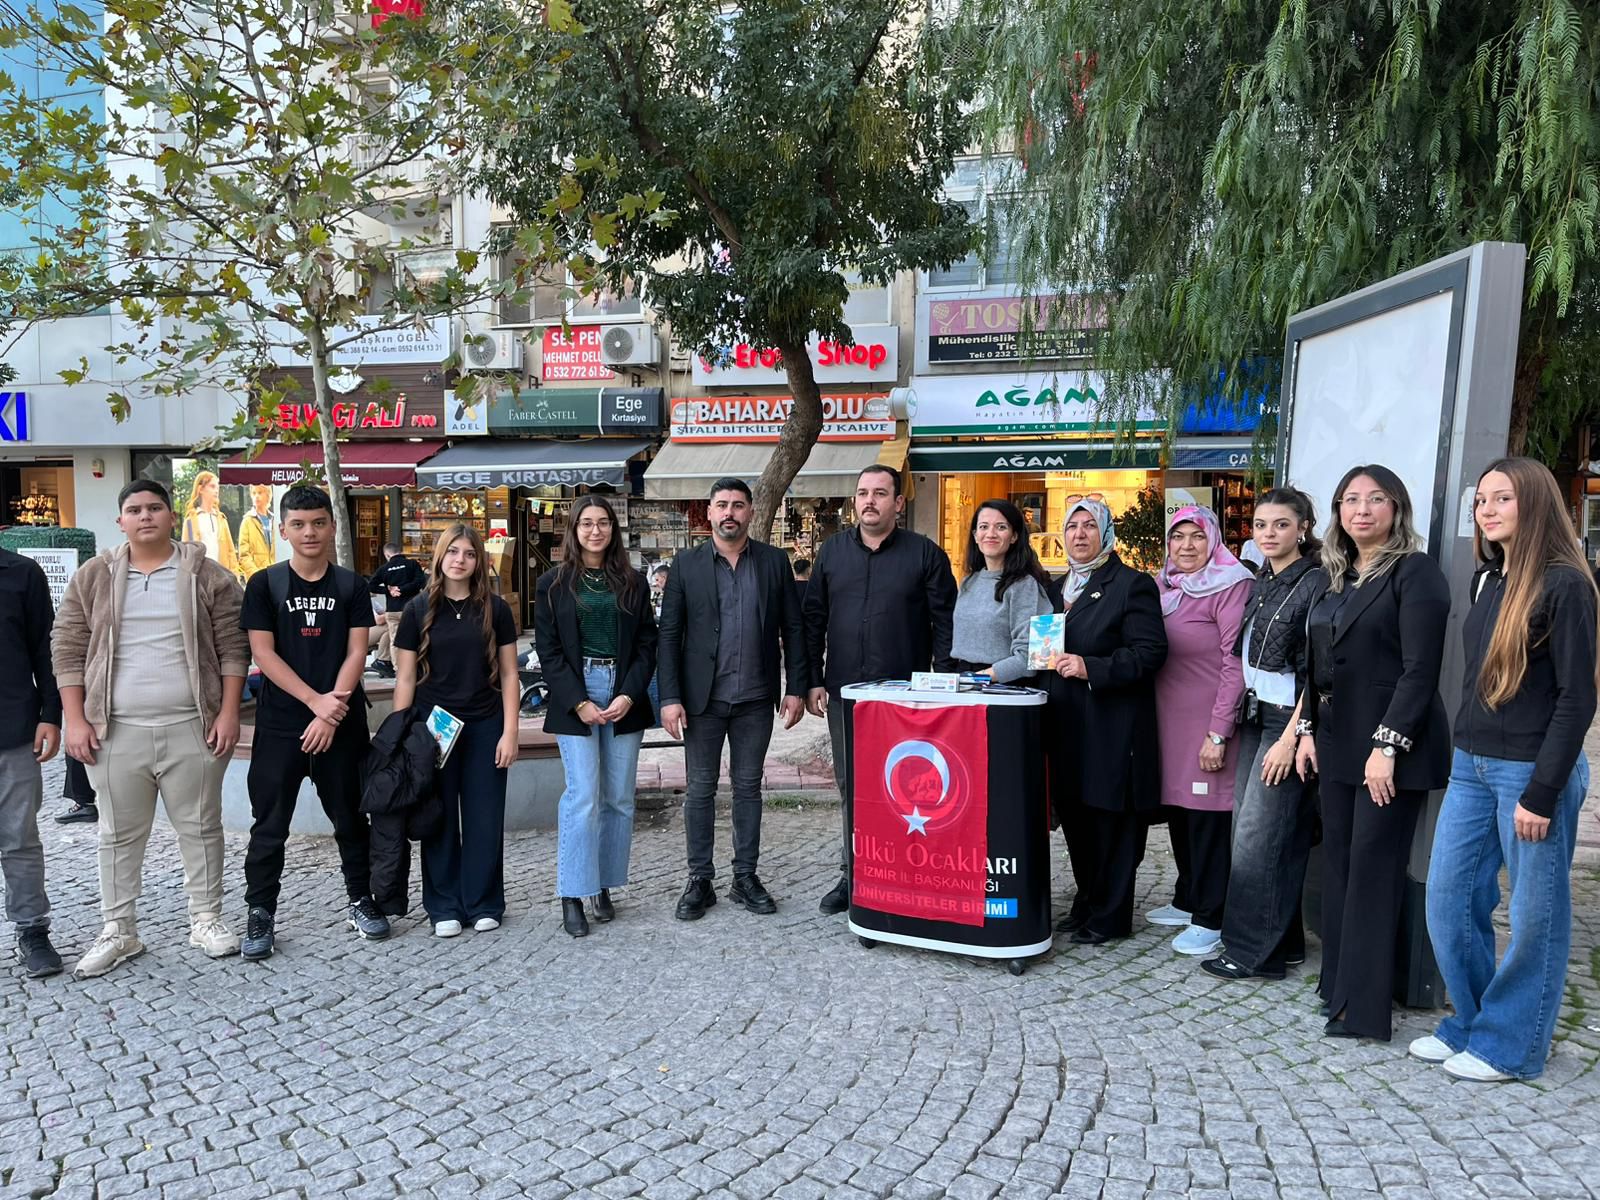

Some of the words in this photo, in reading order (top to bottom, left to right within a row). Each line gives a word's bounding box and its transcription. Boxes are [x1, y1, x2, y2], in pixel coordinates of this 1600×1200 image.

[938, 334, 1016, 345] Mühendislik
[543, 351, 580, 363] MEHMET
[817, 339, 887, 371] Shop
[545, 366, 552, 378] 0
[553, 366, 569, 378] 532
[571, 366, 587, 377] 772
[589, 365, 597, 377] 61
[615, 395, 643, 412] Ege
[975, 384, 1098, 408] AĞAM
[508, 408, 578, 421] FABER-CASTELL
[699, 399, 795, 422] BAHARAT
[821, 397, 864, 420] OLU
[611, 413, 647, 424] Kırtasiye
[837, 423, 888, 432] KAHVE
[993, 453, 1065, 467] AĞAM
[436, 471, 491, 486] EGE
[285, 596, 336, 613] LEGEND
[304, 611, 316, 627] W
[863, 864, 897, 881] İZMİR
[915, 873, 999, 893] BAŞKANLIĞI
[858, 885, 958, 911] ÜNİVERSİTELER
[962, 899, 1008, 916] BİRİMİ
